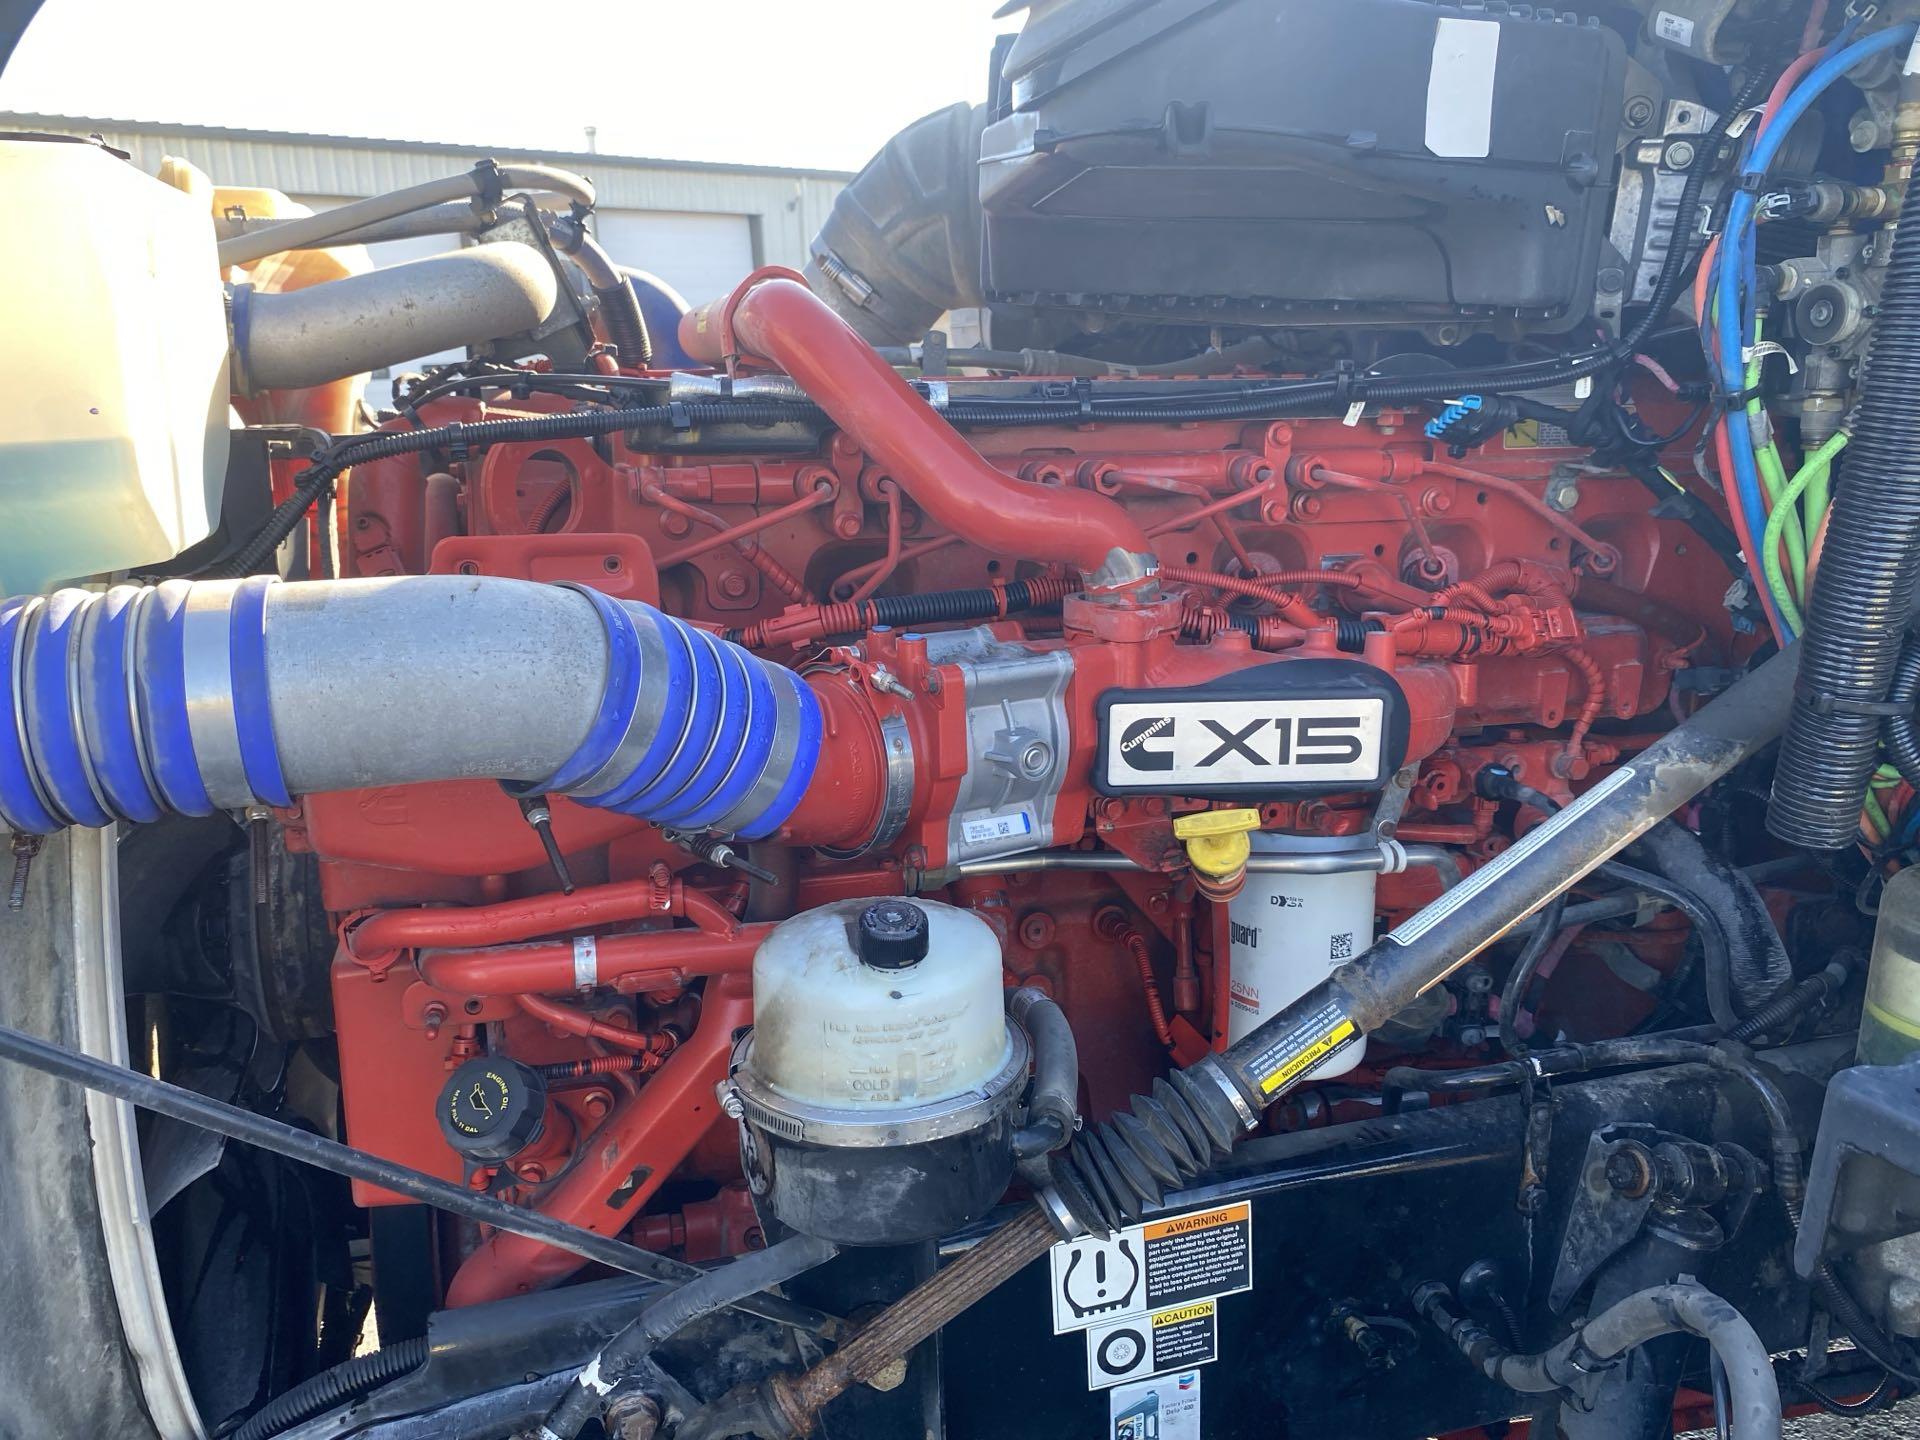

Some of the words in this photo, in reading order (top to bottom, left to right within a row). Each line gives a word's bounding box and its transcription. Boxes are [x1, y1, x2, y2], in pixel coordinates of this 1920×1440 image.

[1120, 716, 1171, 753] Cummins
[1194, 716, 1362, 767] X15
[1231, 981, 1259, 998] 25NN
[1282, 1048, 1321, 1078] PRECAUCION
[486, 1072, 508, 1094] ENGINE
[500, 1097, 508, 1110] OIL
[852, 1079, 890, 1091] COLD
[451, 1089, 460, 1107] MAX
[1175, 1213, 1228, 1231] WARNING
[1148, 1249, 1161, 1257] part
[1172, 1241, 1196, 1251] installed
[1216, 1232, 1237, 1241] original
[1149, 1260, 1173, 1270] different
[1174, 1256, 1191, 1264] wheel
[1192, 1252, 1209, 1260] brand
[1230, 1244, 1246, 1252] could
[1149, 1253, 1179, 1263] equipment
[1207, 1255, 1230, 1263] interfere
[1154, 1274, 1170, 1282] brake
[1172, 1267, 1204, 1278] component
[1223, 1259, 1238, 1267] could
[1191, 1272, 1211, 1280] vehicle
[1184, 1279, 1210, 1290] personal
[1164, 1305, 1212, 1322] CAUTION
[1156, 1327, 1178, 1335] Maintain
[1156, 1339, 1182, 1349] operator's
[1156, 1352, 1182, 1362] tightening
